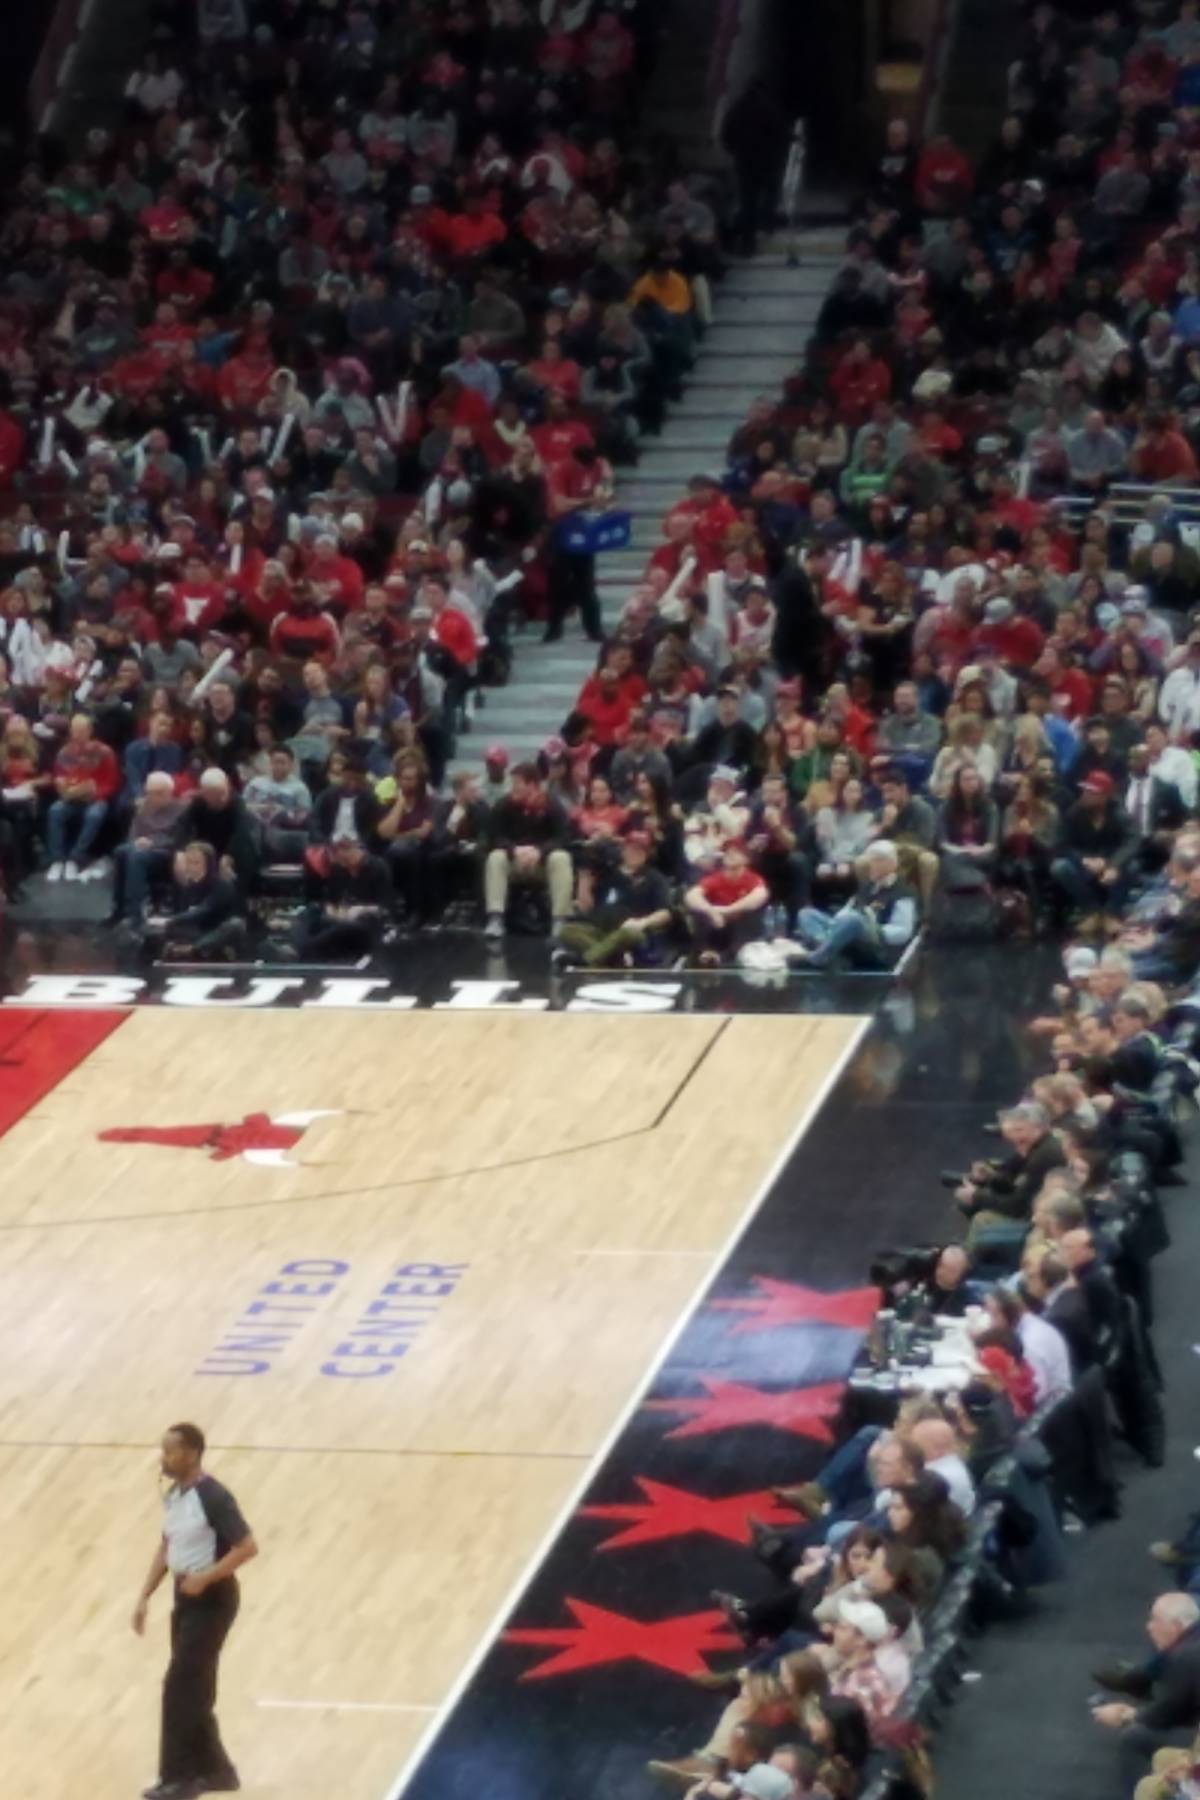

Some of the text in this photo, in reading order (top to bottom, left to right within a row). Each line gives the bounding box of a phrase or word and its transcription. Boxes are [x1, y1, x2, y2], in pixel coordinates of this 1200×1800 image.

[4, 974, 682, 1013] BULLS
[193, 1259, 350, 1376] UNITED
[320, 1261, 469, 1378] CENTER
